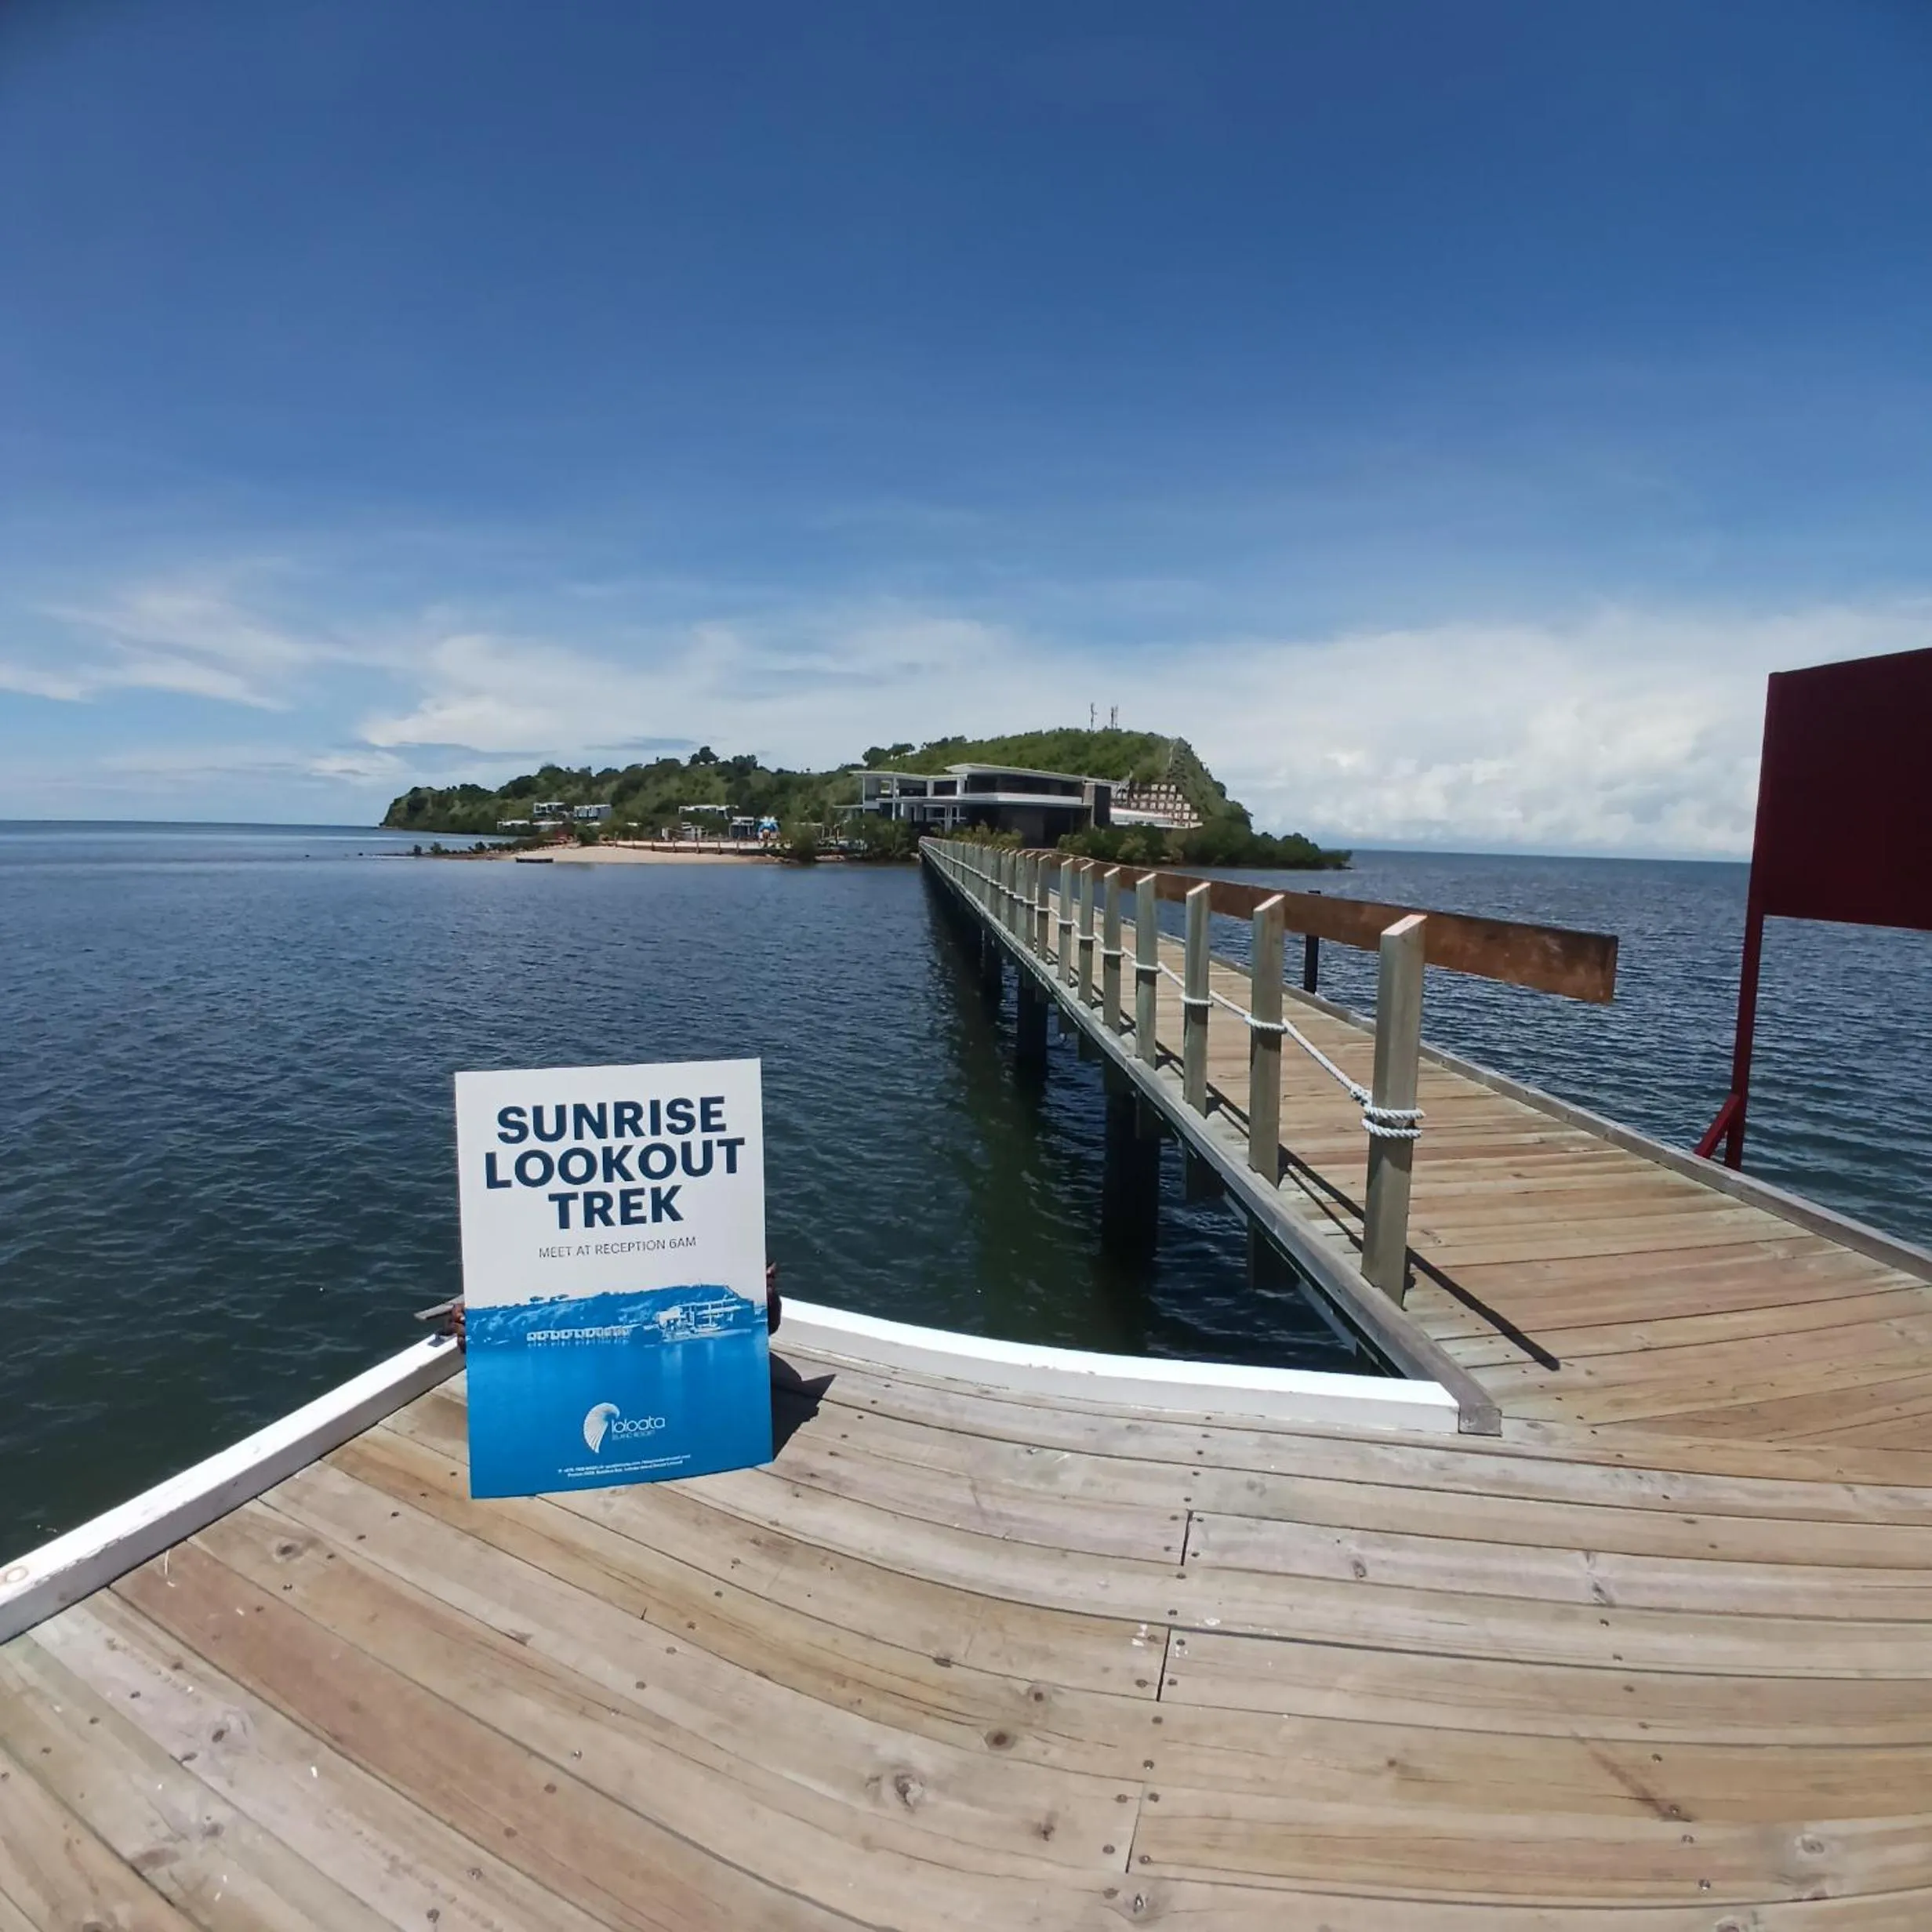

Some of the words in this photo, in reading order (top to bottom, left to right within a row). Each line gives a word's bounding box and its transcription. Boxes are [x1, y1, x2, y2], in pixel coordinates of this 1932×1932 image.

[496, 1095, 727, 1145] SUNRISE
[485, 1137, 746, 1189] LOOKOUT
[547, 1184, 685, 1230] TREK
[539, 1245, 571, 1258] MEET
[576, 1244, 590, 1256] AT
[595, 1239, 666, 1255] RECEPTION
[670, 1236, 696, 1248] 6AM
